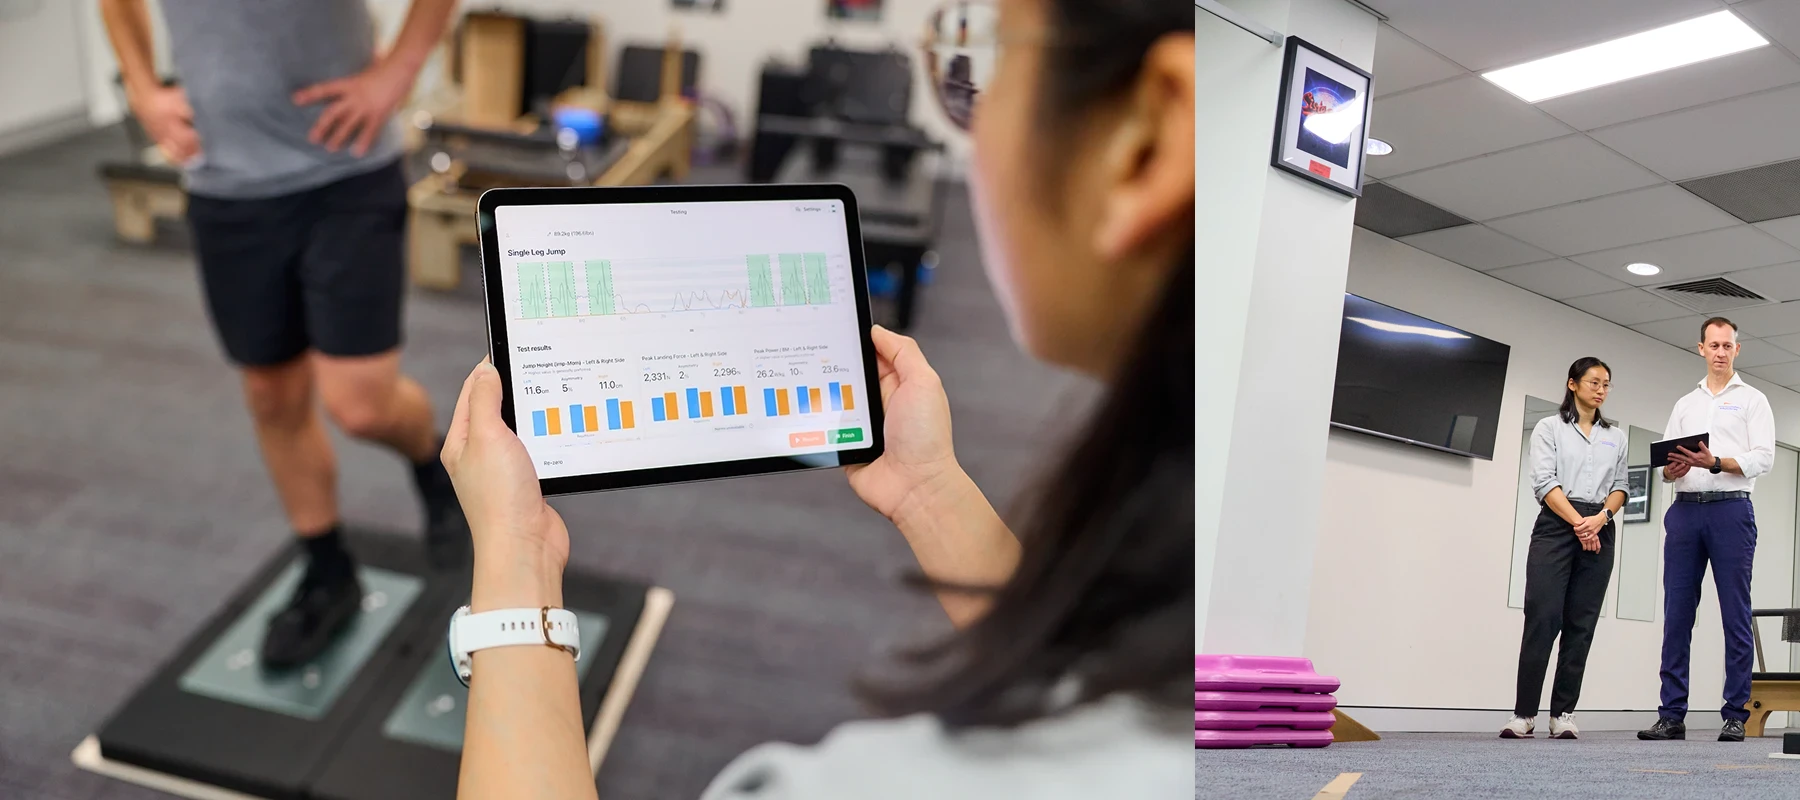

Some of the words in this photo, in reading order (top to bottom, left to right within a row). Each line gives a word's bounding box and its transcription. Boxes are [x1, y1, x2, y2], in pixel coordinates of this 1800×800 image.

[507, 249, 530, 257] Single
[531, 249, 544, 257] Leg
[546, 248, 566, 256] Jump
